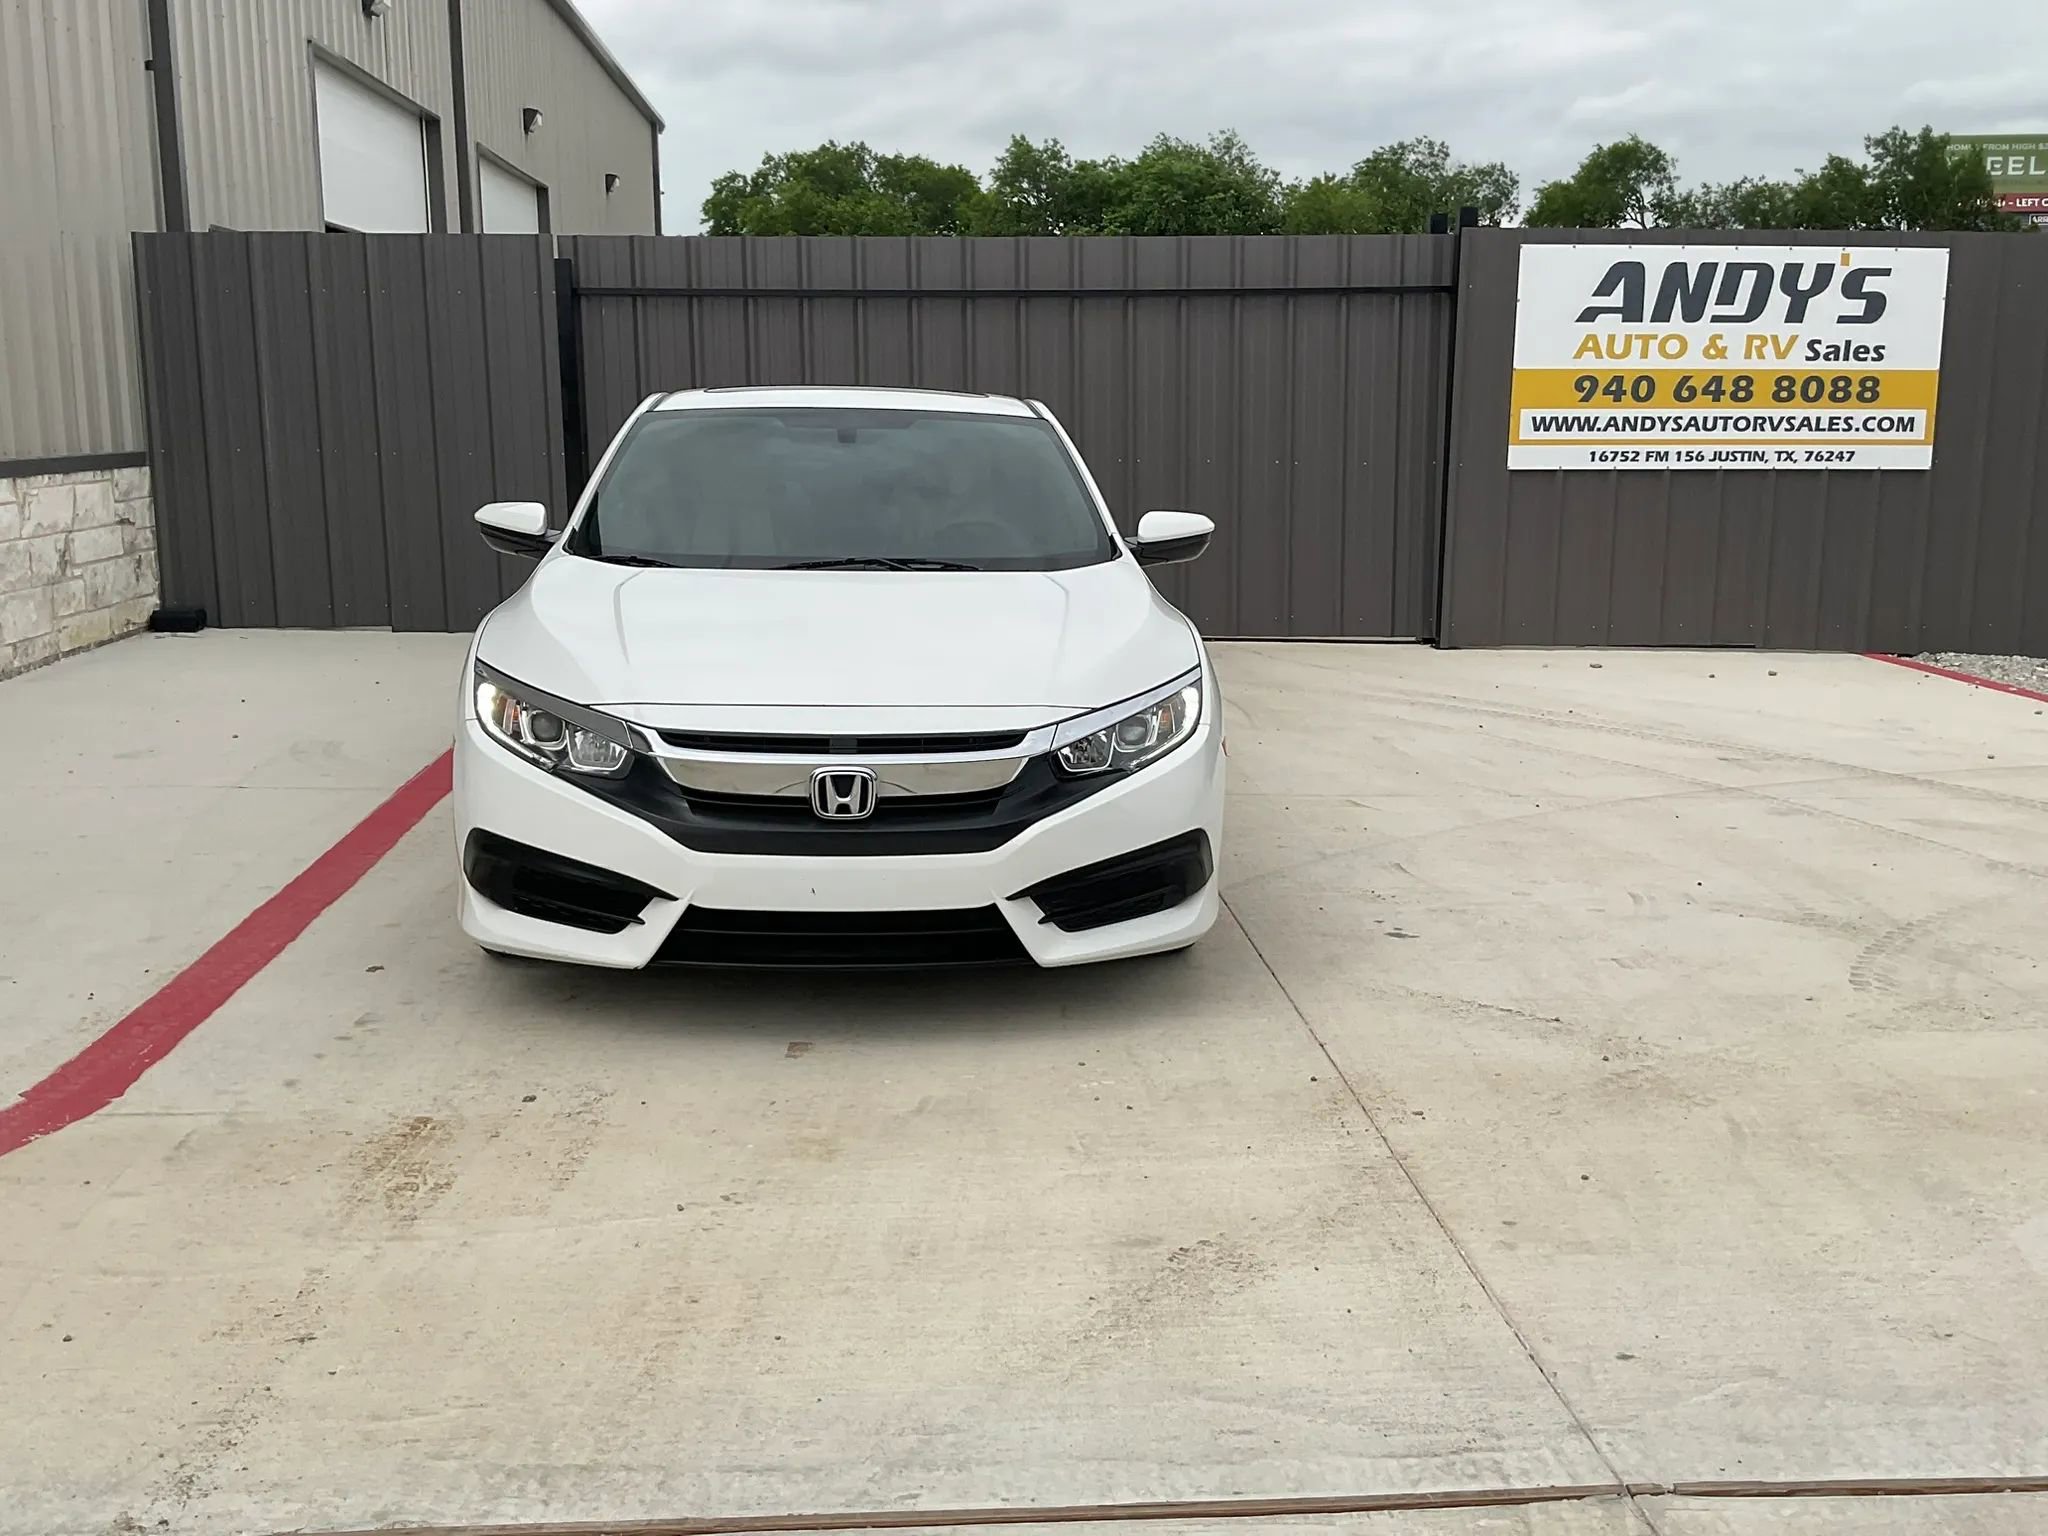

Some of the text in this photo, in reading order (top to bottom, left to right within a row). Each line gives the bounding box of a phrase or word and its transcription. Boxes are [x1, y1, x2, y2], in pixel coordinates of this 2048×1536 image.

[2016, 198, 2040, 207] LEFT
[1574, 252, 1893, 324] ANDY'S
[1573, 333, 1886, 362] AUTO & RV Sales
[1573, 375, 1881, 403] 940 648 8088
[1531, 415, 1916, 433] WWW.ANDYSAUTORVSALES.COM
[1589, 450, 1856, 464] 16752 FM 156 JUSTIN, TX, 76247
